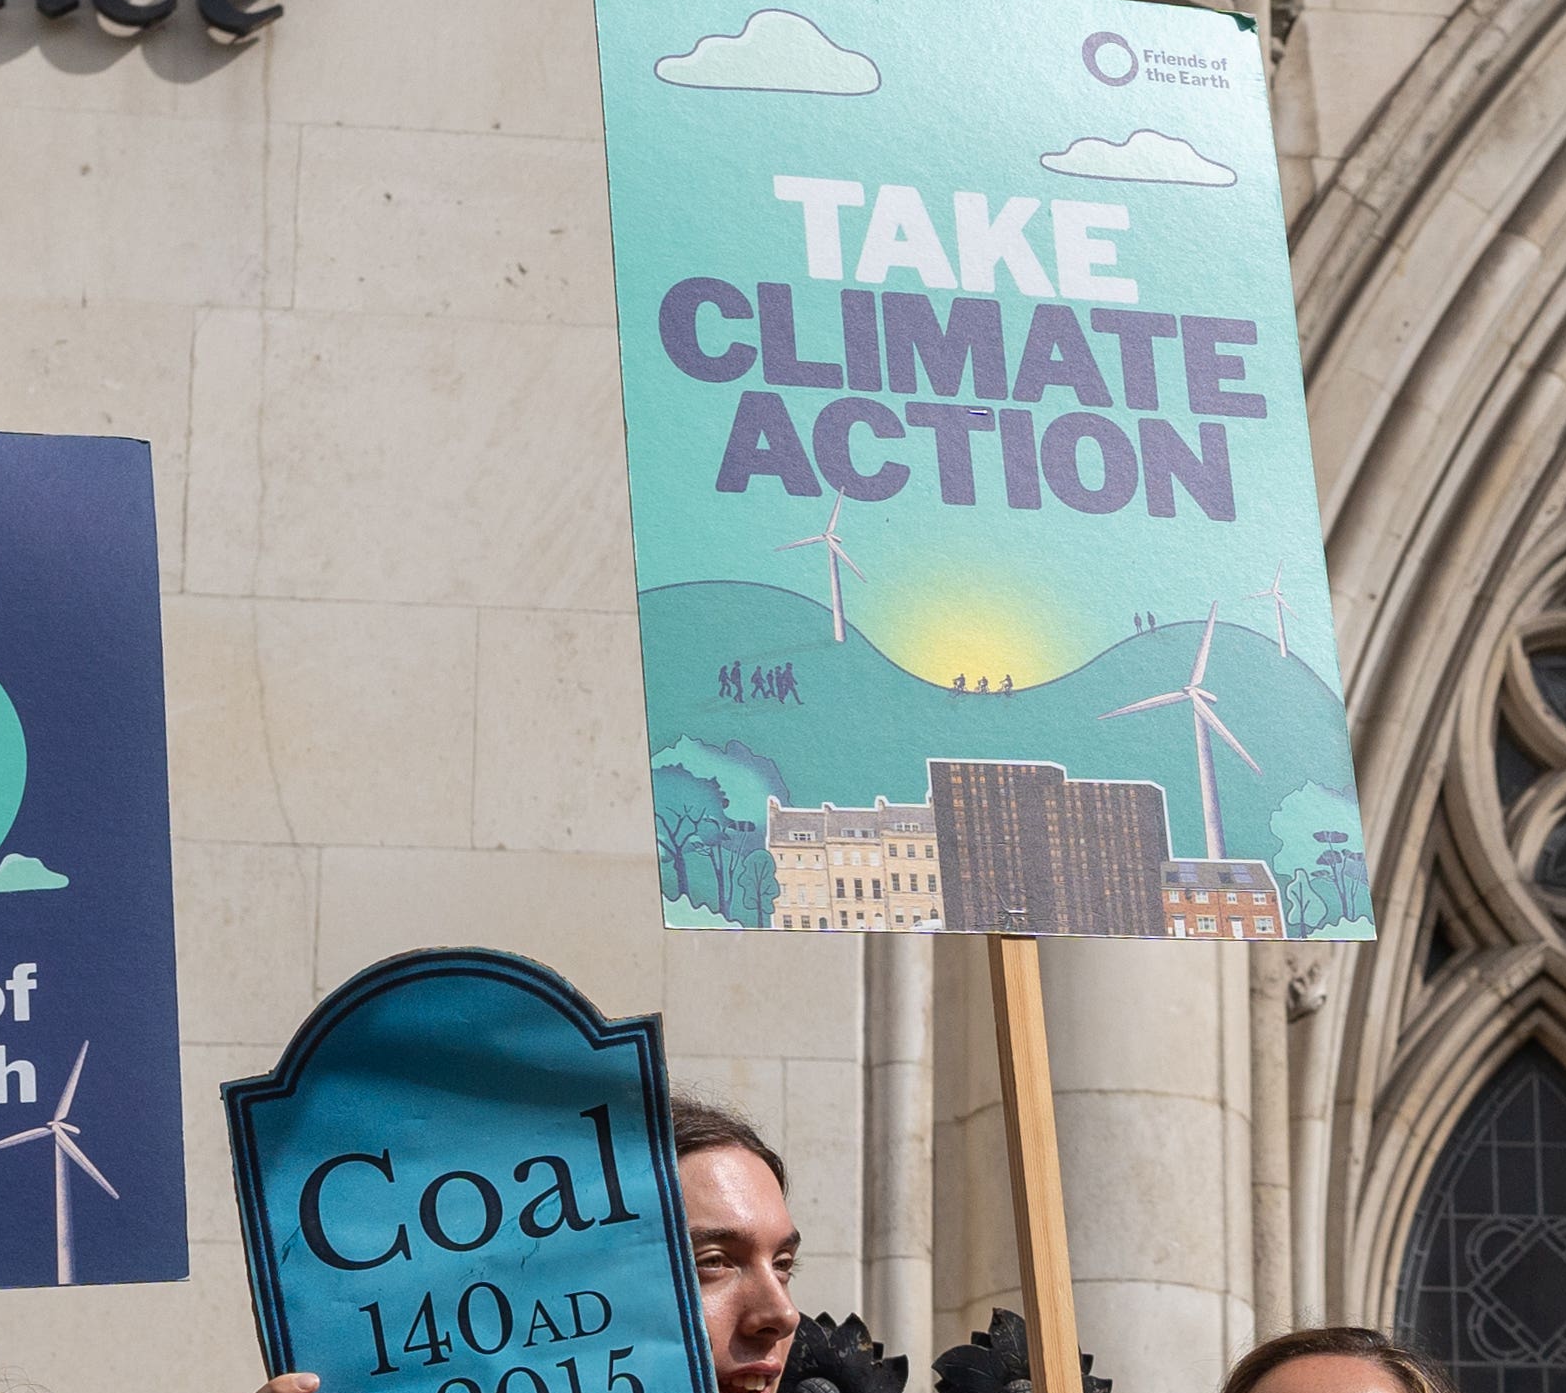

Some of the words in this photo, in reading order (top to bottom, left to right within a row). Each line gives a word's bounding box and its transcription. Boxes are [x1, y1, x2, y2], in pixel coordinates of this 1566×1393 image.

[1143, 48, 1208, 70] Friends
[1211, 58, 1228, 72] of
[1145, 67, 1176, 84] the
[1179, 70, 1230, 89] Earth
[773, 174, 1139, 304] TAKE
[658, 276, 1267, 420] CLIMATE
[714, 390, 1237, 522] ACTION
[297, 1103, 641, 1272] Coal
